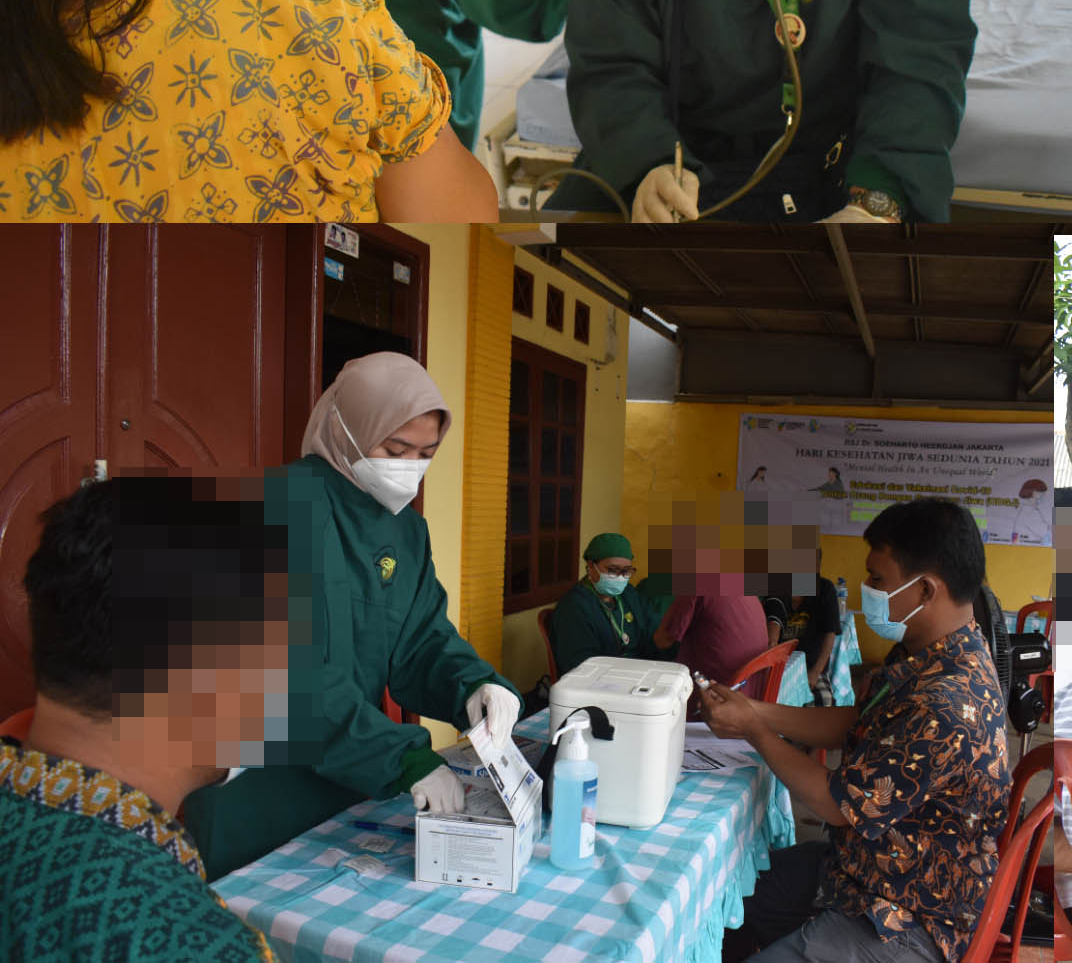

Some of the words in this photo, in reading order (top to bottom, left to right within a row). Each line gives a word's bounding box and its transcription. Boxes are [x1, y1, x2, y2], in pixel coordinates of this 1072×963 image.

[966, 444, 1004, 452] JAKARTA
[796, 448, 824, 458] HARI
[827, 449, 895, 461] KESEHATAN
[898, 452, 924, 463] JIWA
[927, 453, 980, 465] SEDUNIA
[984, 455, 1025, 467] TAHUN
[1029, 457, 1050, 468] 2021
